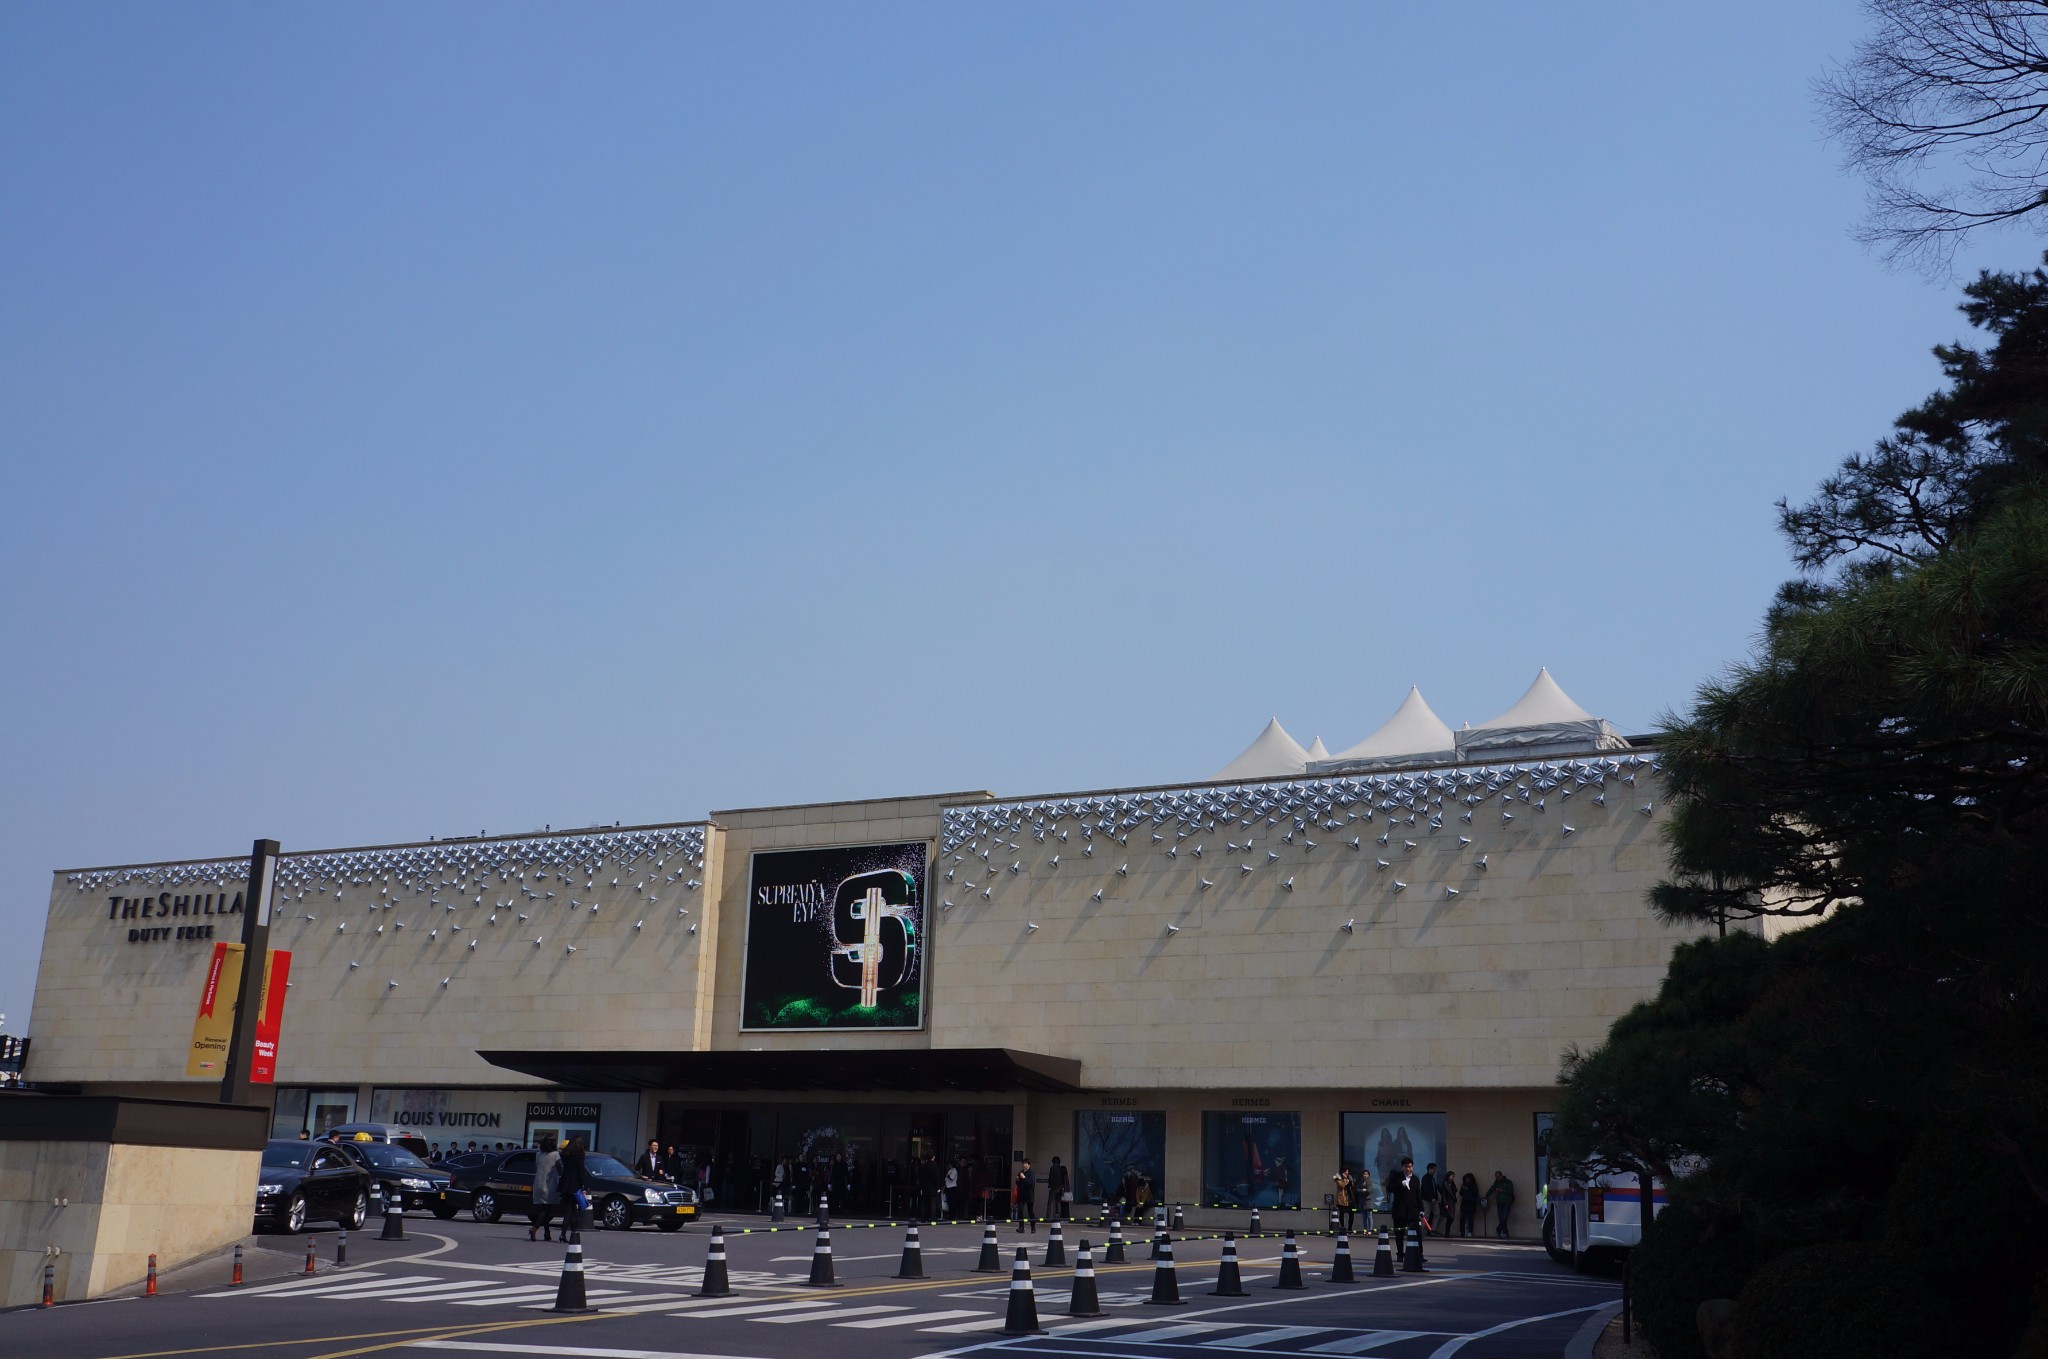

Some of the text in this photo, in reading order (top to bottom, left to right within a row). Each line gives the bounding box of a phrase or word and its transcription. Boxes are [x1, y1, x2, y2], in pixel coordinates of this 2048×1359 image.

[128, 925, 215, 942] DUTY FREE
[194, 1041, 226, 1052] Opening
[255, 1040, 275, 1049] Beauty
[258, 1049, 274, 1058] Week
[529, 1105, 597, 1116] LOUIS VUITTON
[394, 1111, 500, 1128] LOUIS VUITTON
